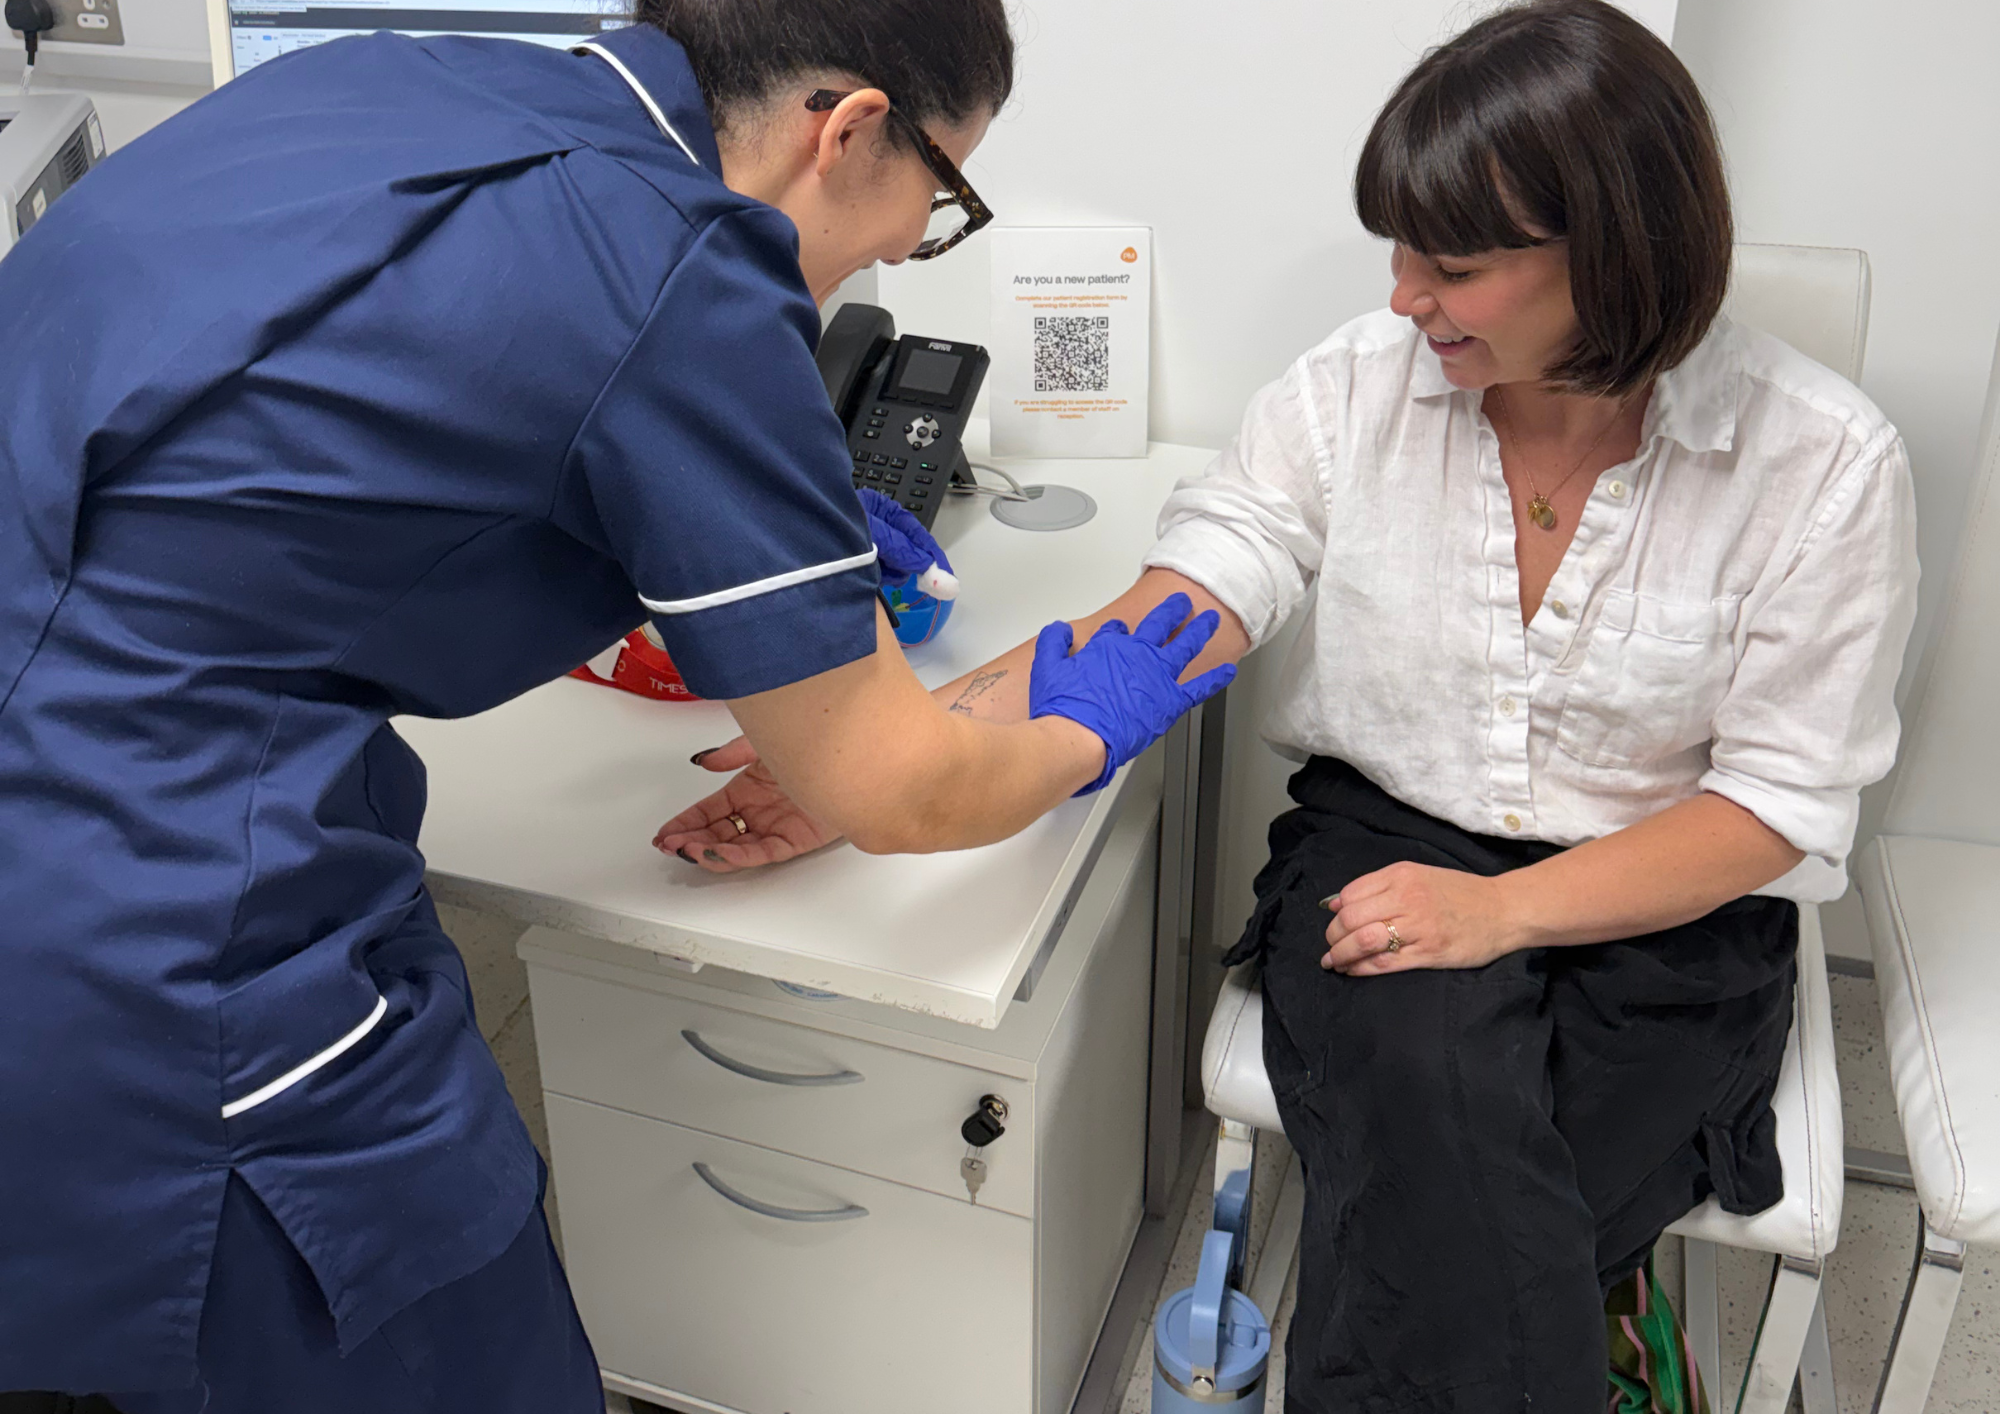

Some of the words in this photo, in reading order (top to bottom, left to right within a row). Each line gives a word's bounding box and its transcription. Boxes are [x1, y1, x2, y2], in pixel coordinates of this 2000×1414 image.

[1123, 252, 1135, 260] PM
[1013, 275, 1031, 284] Are
[1034, 276, 1052, 286] you
[1055, 276, 1062, 284] a
[1064, 276, 1085, 284] new
[1088, 274, 1130, 285] patient?
[1120, 294, 1127, 302] by
[648, 676, 689, 694] TIMES
